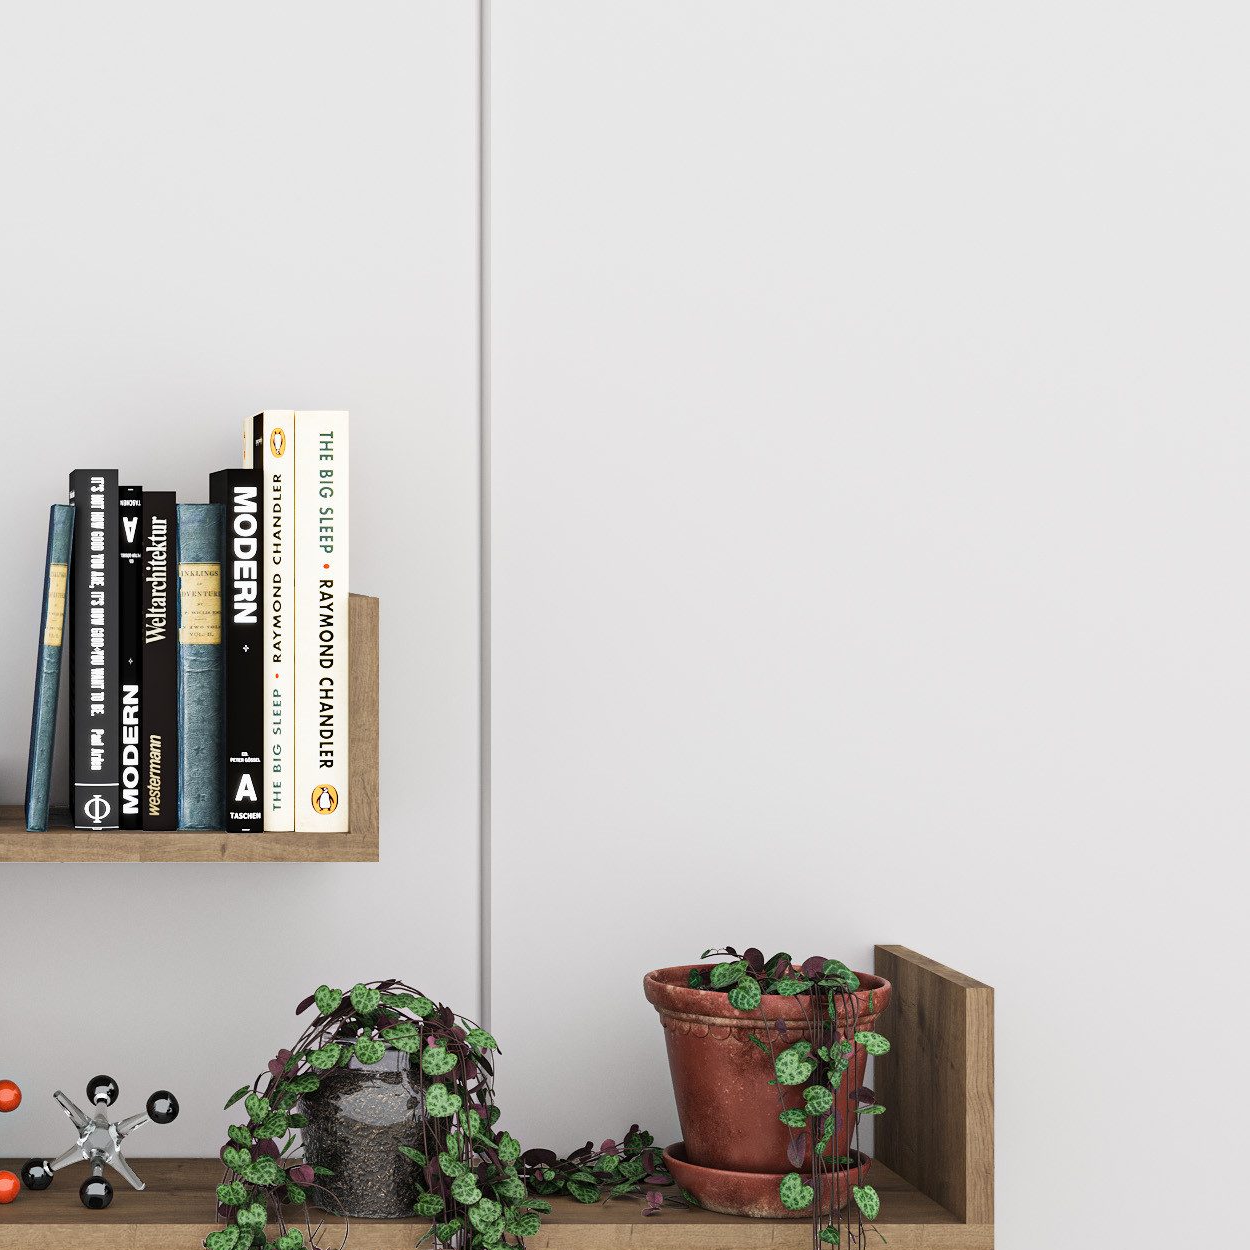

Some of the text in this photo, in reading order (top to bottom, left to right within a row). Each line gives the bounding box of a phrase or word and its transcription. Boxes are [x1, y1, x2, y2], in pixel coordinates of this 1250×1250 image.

[90, 476, 104, 492] IT'S
[122, 516, 138, 543] A
[233, 486, 258, 624] MODERN
[90, 591, 104, 606] IT'S
[145, 516, 167, 644] Weltarchitektur
[319, 431, 334, 769] THE BIG SLEEP RAYMOND CHANDLER
[273, 474, 282, 811] THE BIG SLEEP RAYMOND CHANDLER
[122, 684, 139, 815] MODERN
[149, 734, 162, 816] westermann
[234, 773, 258, 801] A
[230, 812, 261, 820] TASCHEN
